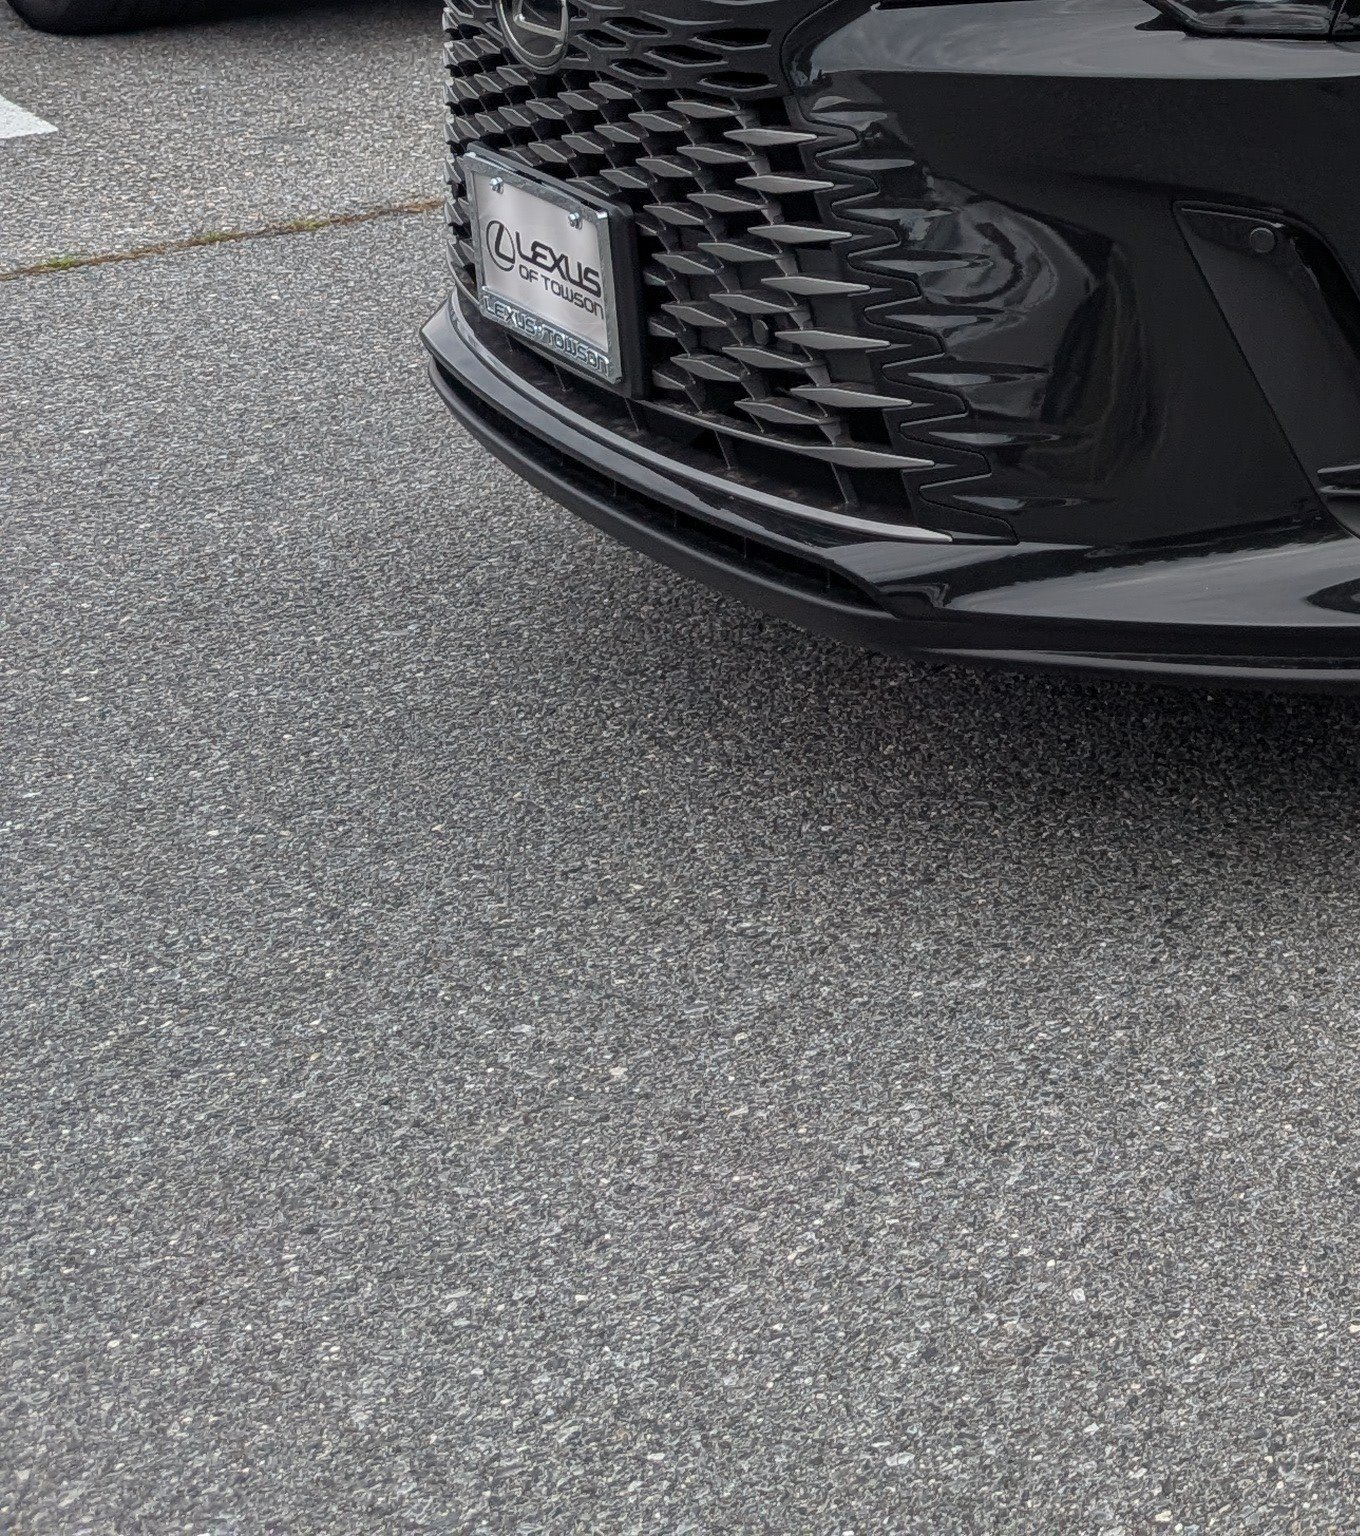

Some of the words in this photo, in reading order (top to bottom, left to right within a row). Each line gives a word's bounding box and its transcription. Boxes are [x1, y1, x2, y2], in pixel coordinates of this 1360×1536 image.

[516, 231, 602, 299] LEXUS
[519, 264, 539, 283] OF
[541, 274, 604, 320] TOWSON
[482, 294, 537, 336] LEXUS
